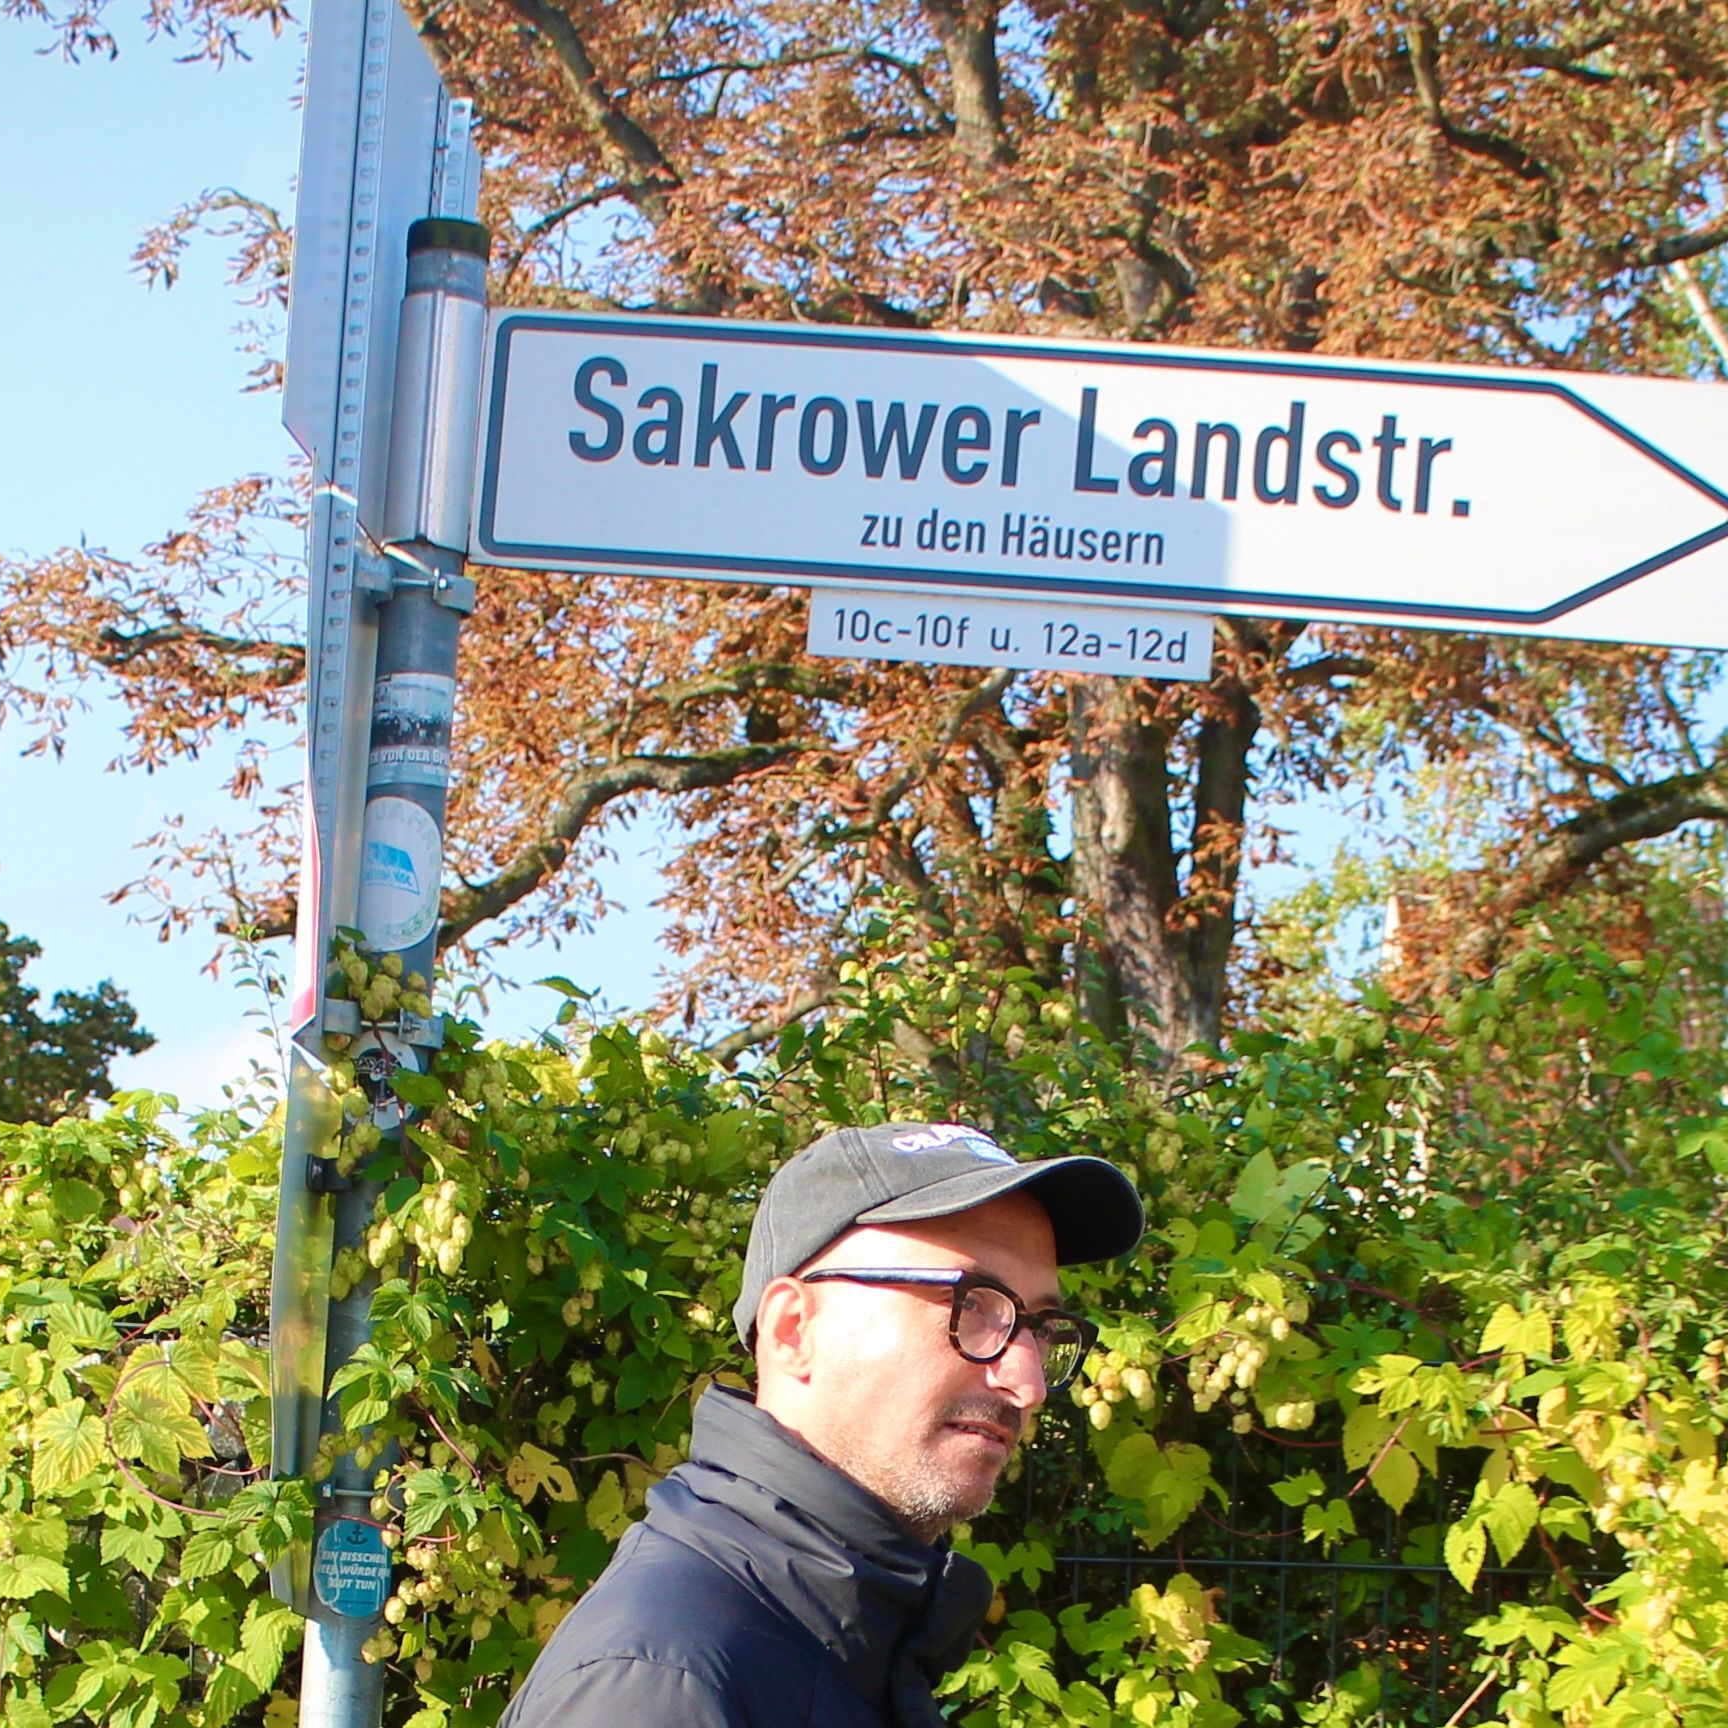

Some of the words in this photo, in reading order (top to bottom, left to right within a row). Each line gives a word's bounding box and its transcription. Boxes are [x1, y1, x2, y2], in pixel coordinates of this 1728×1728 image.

[567, 354, 1043, 489] Sakrower
[1072, 386, 1471, 518] Landstr.
[859, 513, 903, 549] zu
[916, 507, 986, 555] den
[999, 511, 1165, 567] Häusern
[834, 607, 972, 650] 10c-10f
[989, 626, 1022, 655] u.
[1042, 621, 1189, 665] 12a-12d
[339, 1563, 376, 1576] WÜRDE
